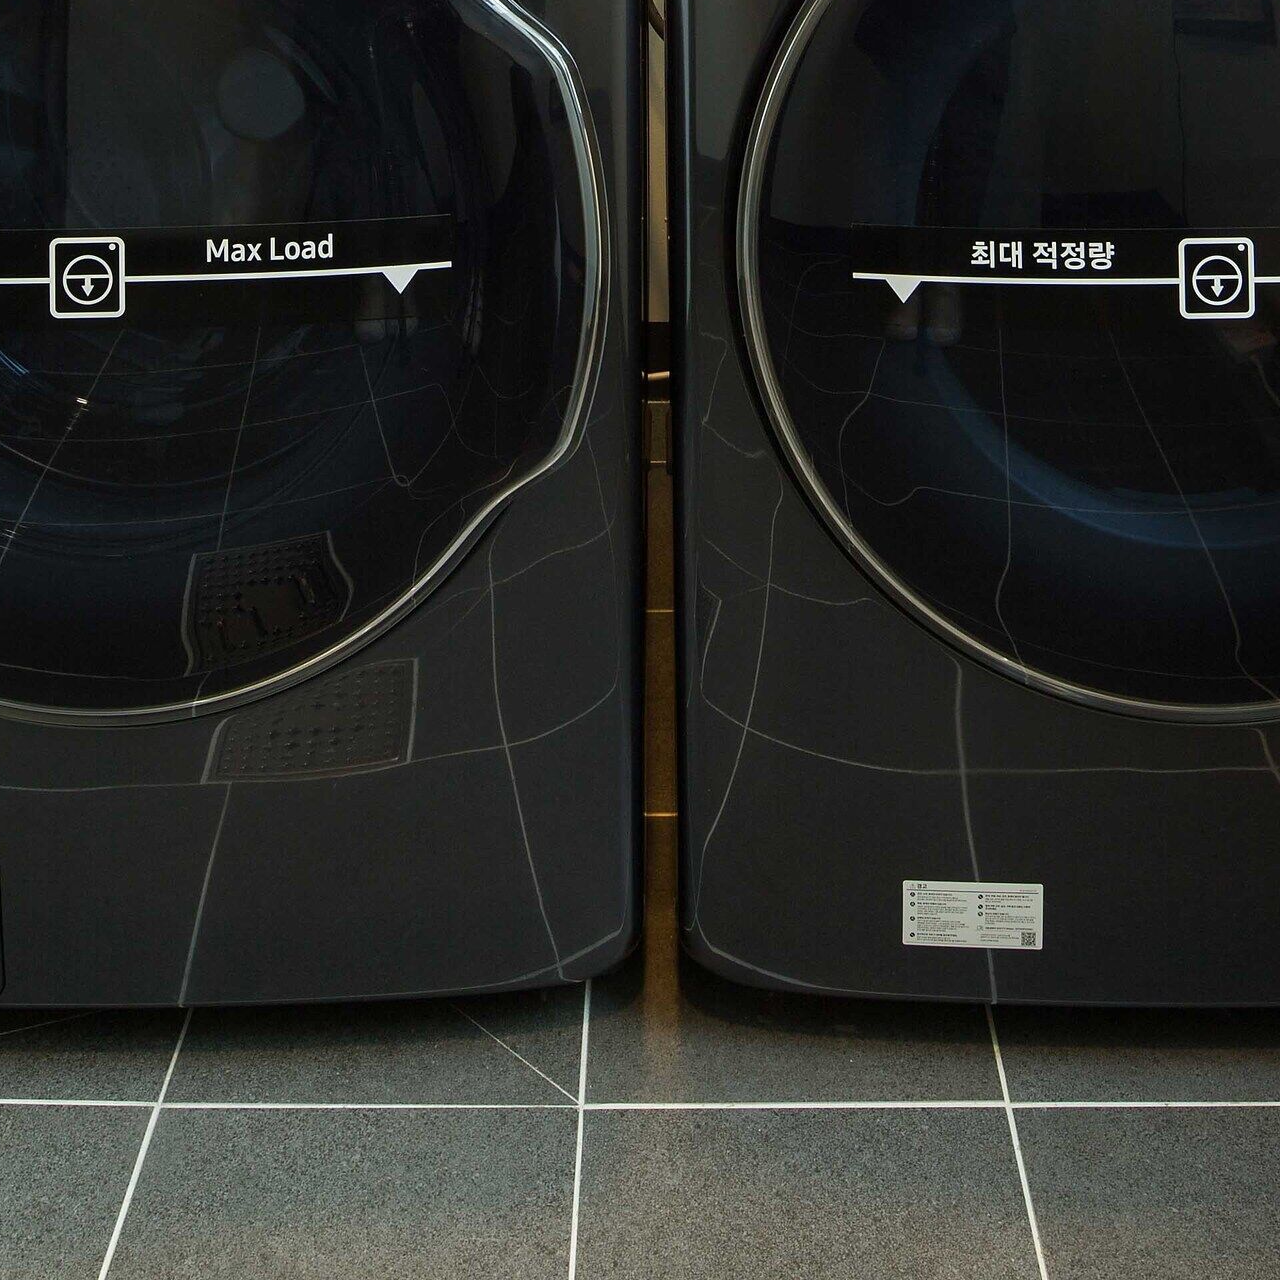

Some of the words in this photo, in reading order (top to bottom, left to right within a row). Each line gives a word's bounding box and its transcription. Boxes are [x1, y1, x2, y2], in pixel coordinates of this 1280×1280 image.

[206, 238, 262, 263] Max
[270, 233, 334, 261] Load
[970, 240, 1023, 269] 최대
[1032, 241, 1115, 270] 적정량
